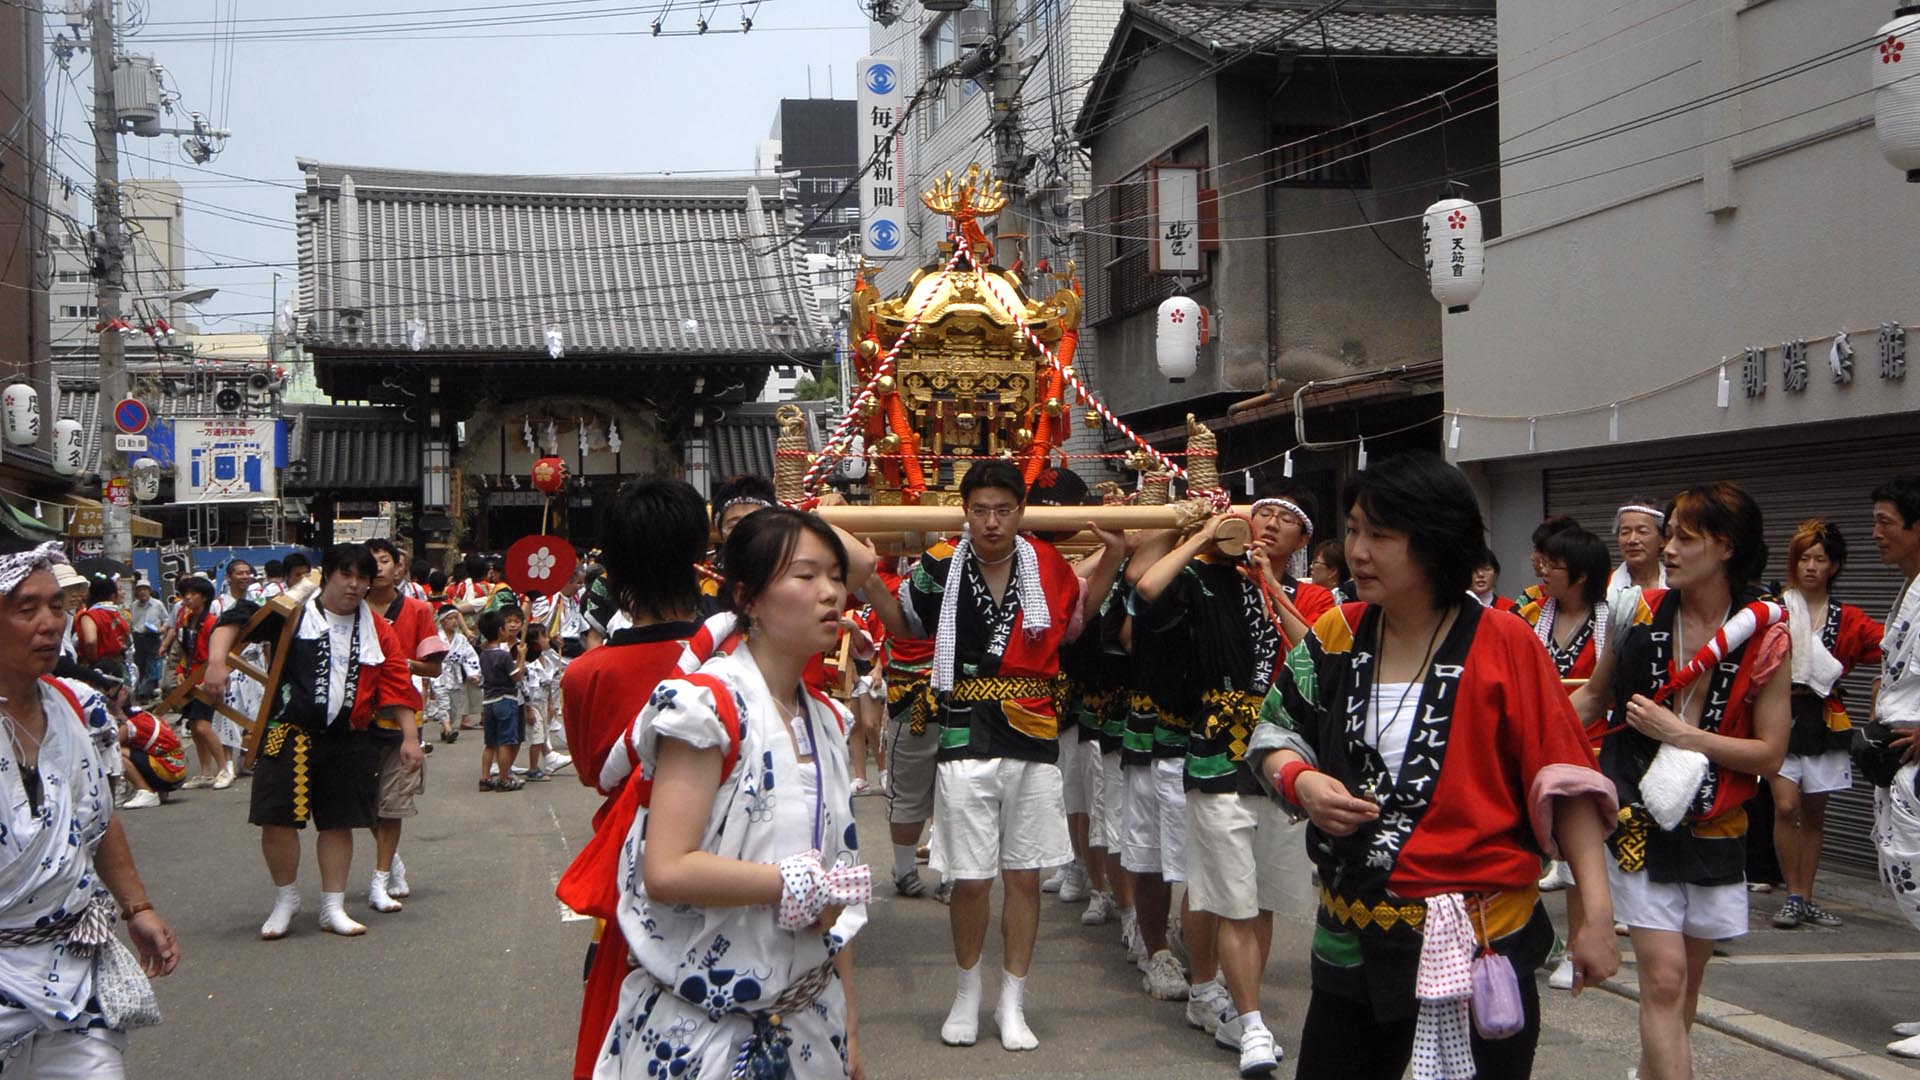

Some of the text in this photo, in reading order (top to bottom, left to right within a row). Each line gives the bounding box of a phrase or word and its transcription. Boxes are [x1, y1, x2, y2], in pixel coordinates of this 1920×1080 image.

[871, 105, 893, 208] 毎日新聞
[117, 438, 146, 448] 自動車
